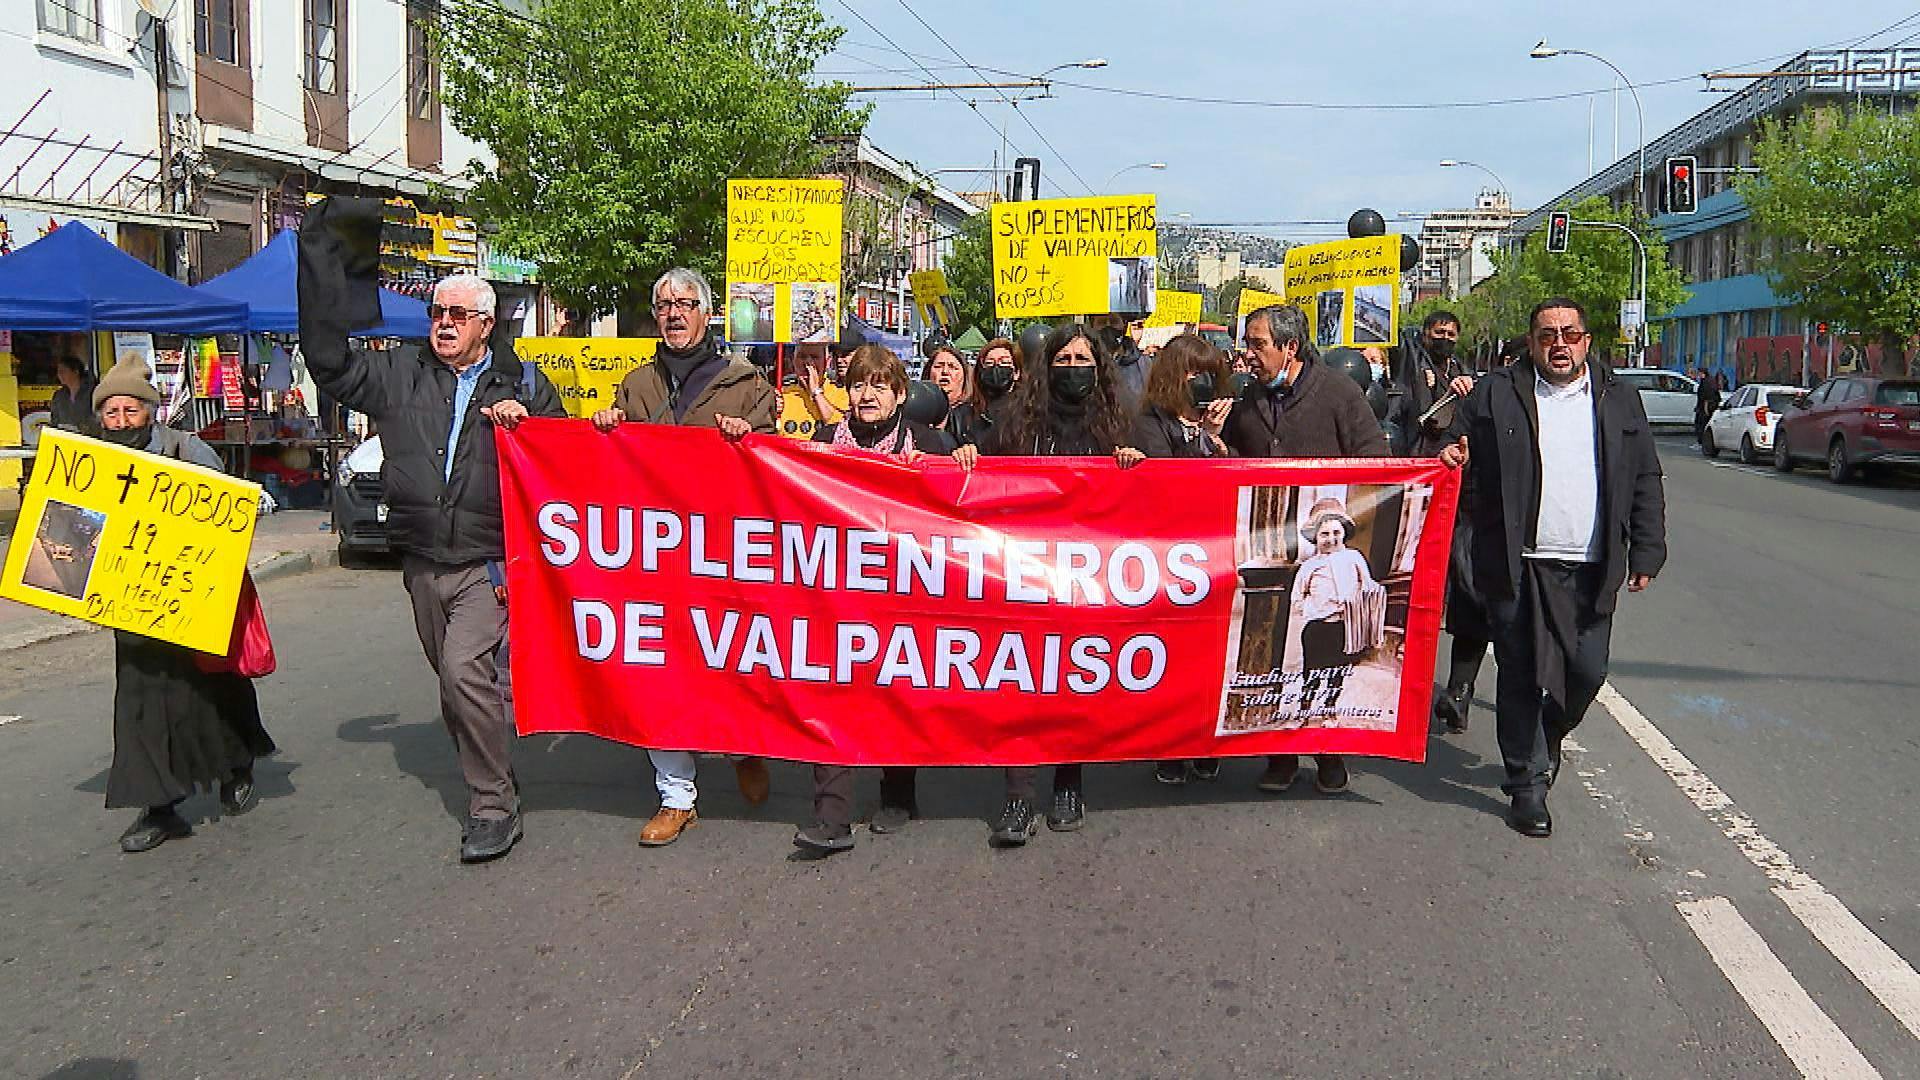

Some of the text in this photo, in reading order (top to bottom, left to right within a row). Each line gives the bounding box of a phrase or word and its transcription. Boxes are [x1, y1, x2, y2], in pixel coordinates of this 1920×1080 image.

[771, 207, 805, 224] NOS
[999, 204, 1156, 237] SUPLEMENTEROS
[733, 228, 832, 247] ESCUCHEN
[1009, 237, 1030, 260] DE
[727, 259, 840, 282] AUTORIDADES
[1001, 263, 1051, 285] NO +
[997, 280, 1065, 309] ROBOS
[45, 443, 97, 493] NO
[148, 471, 256, 533] ROBOS
[122, 519, 217, 565] 19 EN
[536, 501, 1210, 608] SUPLEMENTEROS
[102, 551, 129, 574] UN
[140, 561, 194, 593] MES
[572, 598, 1168, 694] DE VALPARAISO
